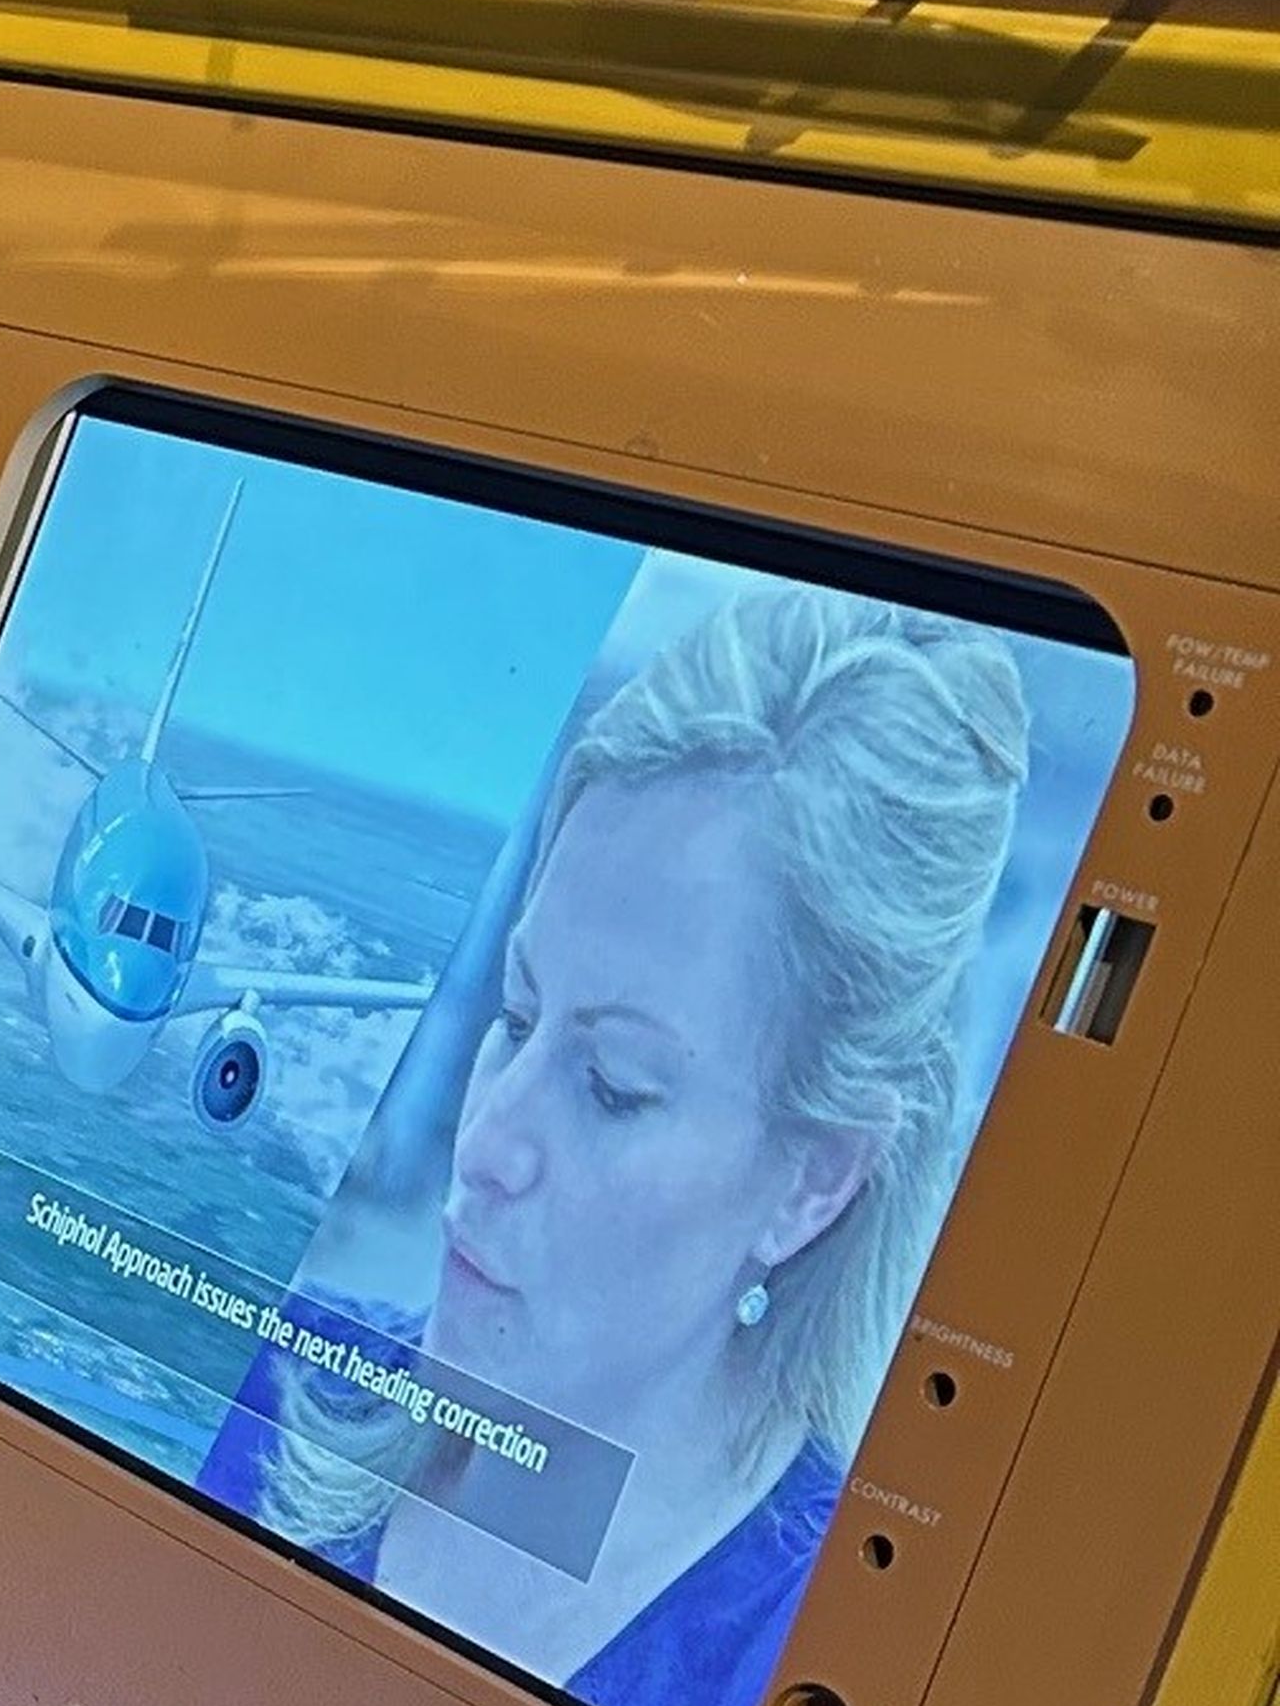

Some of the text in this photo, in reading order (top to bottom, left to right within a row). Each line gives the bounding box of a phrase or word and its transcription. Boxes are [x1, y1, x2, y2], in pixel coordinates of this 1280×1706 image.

[1172, 659, 1247, 689] FAILURE
[1151, 743, 1203, 771] DATA
[1132, 763, 1207, 794] FAILURE
[1091, 879, 1161, 911] POWER
[25, 1192, 550, 1474] Schiphol Approach issues the next heading correction
[849, 1476, 943, 1528] CONTRAST
